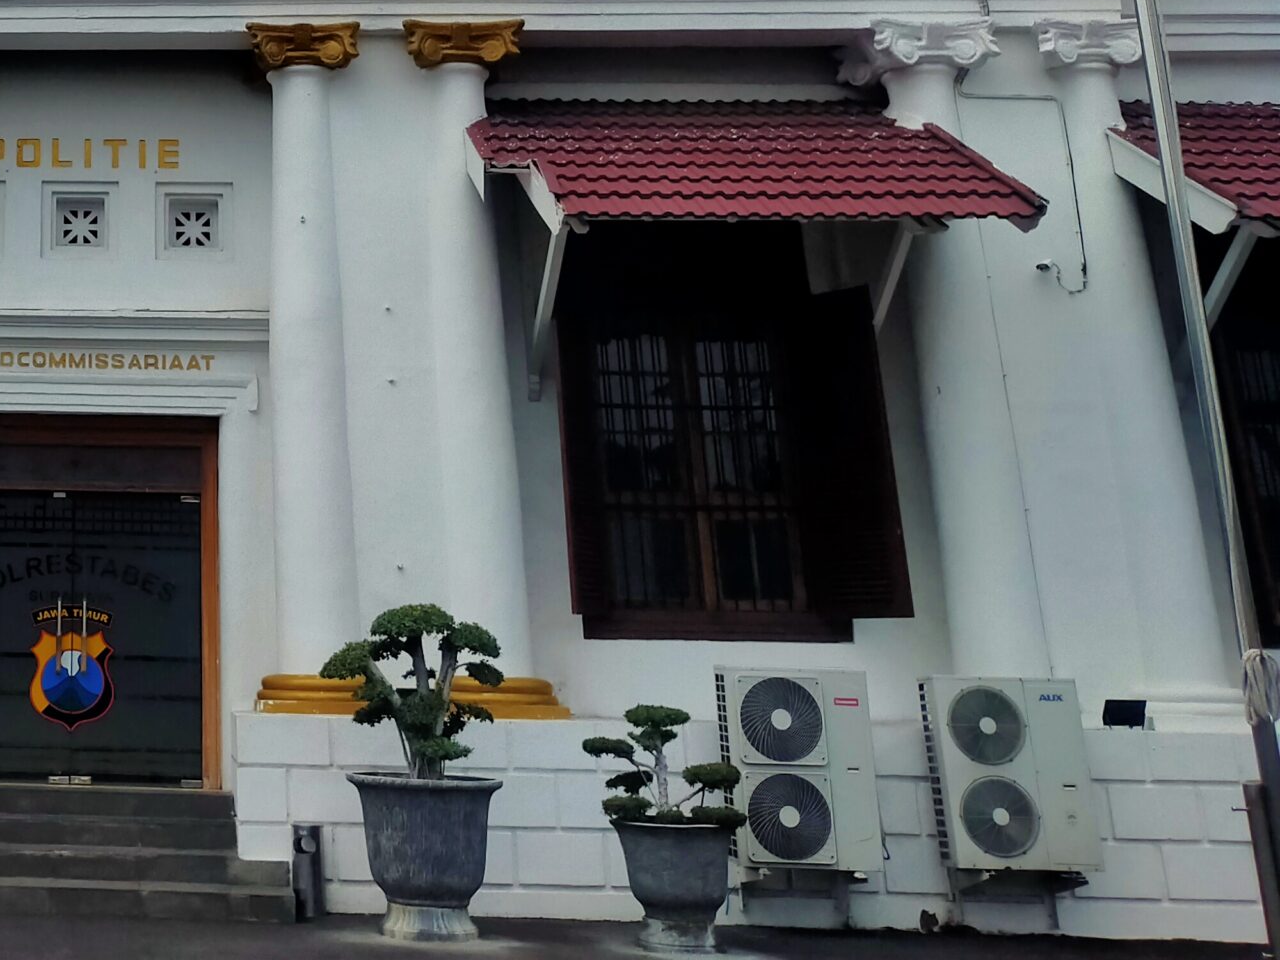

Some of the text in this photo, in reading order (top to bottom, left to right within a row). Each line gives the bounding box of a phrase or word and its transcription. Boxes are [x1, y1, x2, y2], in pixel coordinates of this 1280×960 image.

[36, 608, 110, 623] JAWA TIMUR
[1038, 694, 1064, 702] AUX
